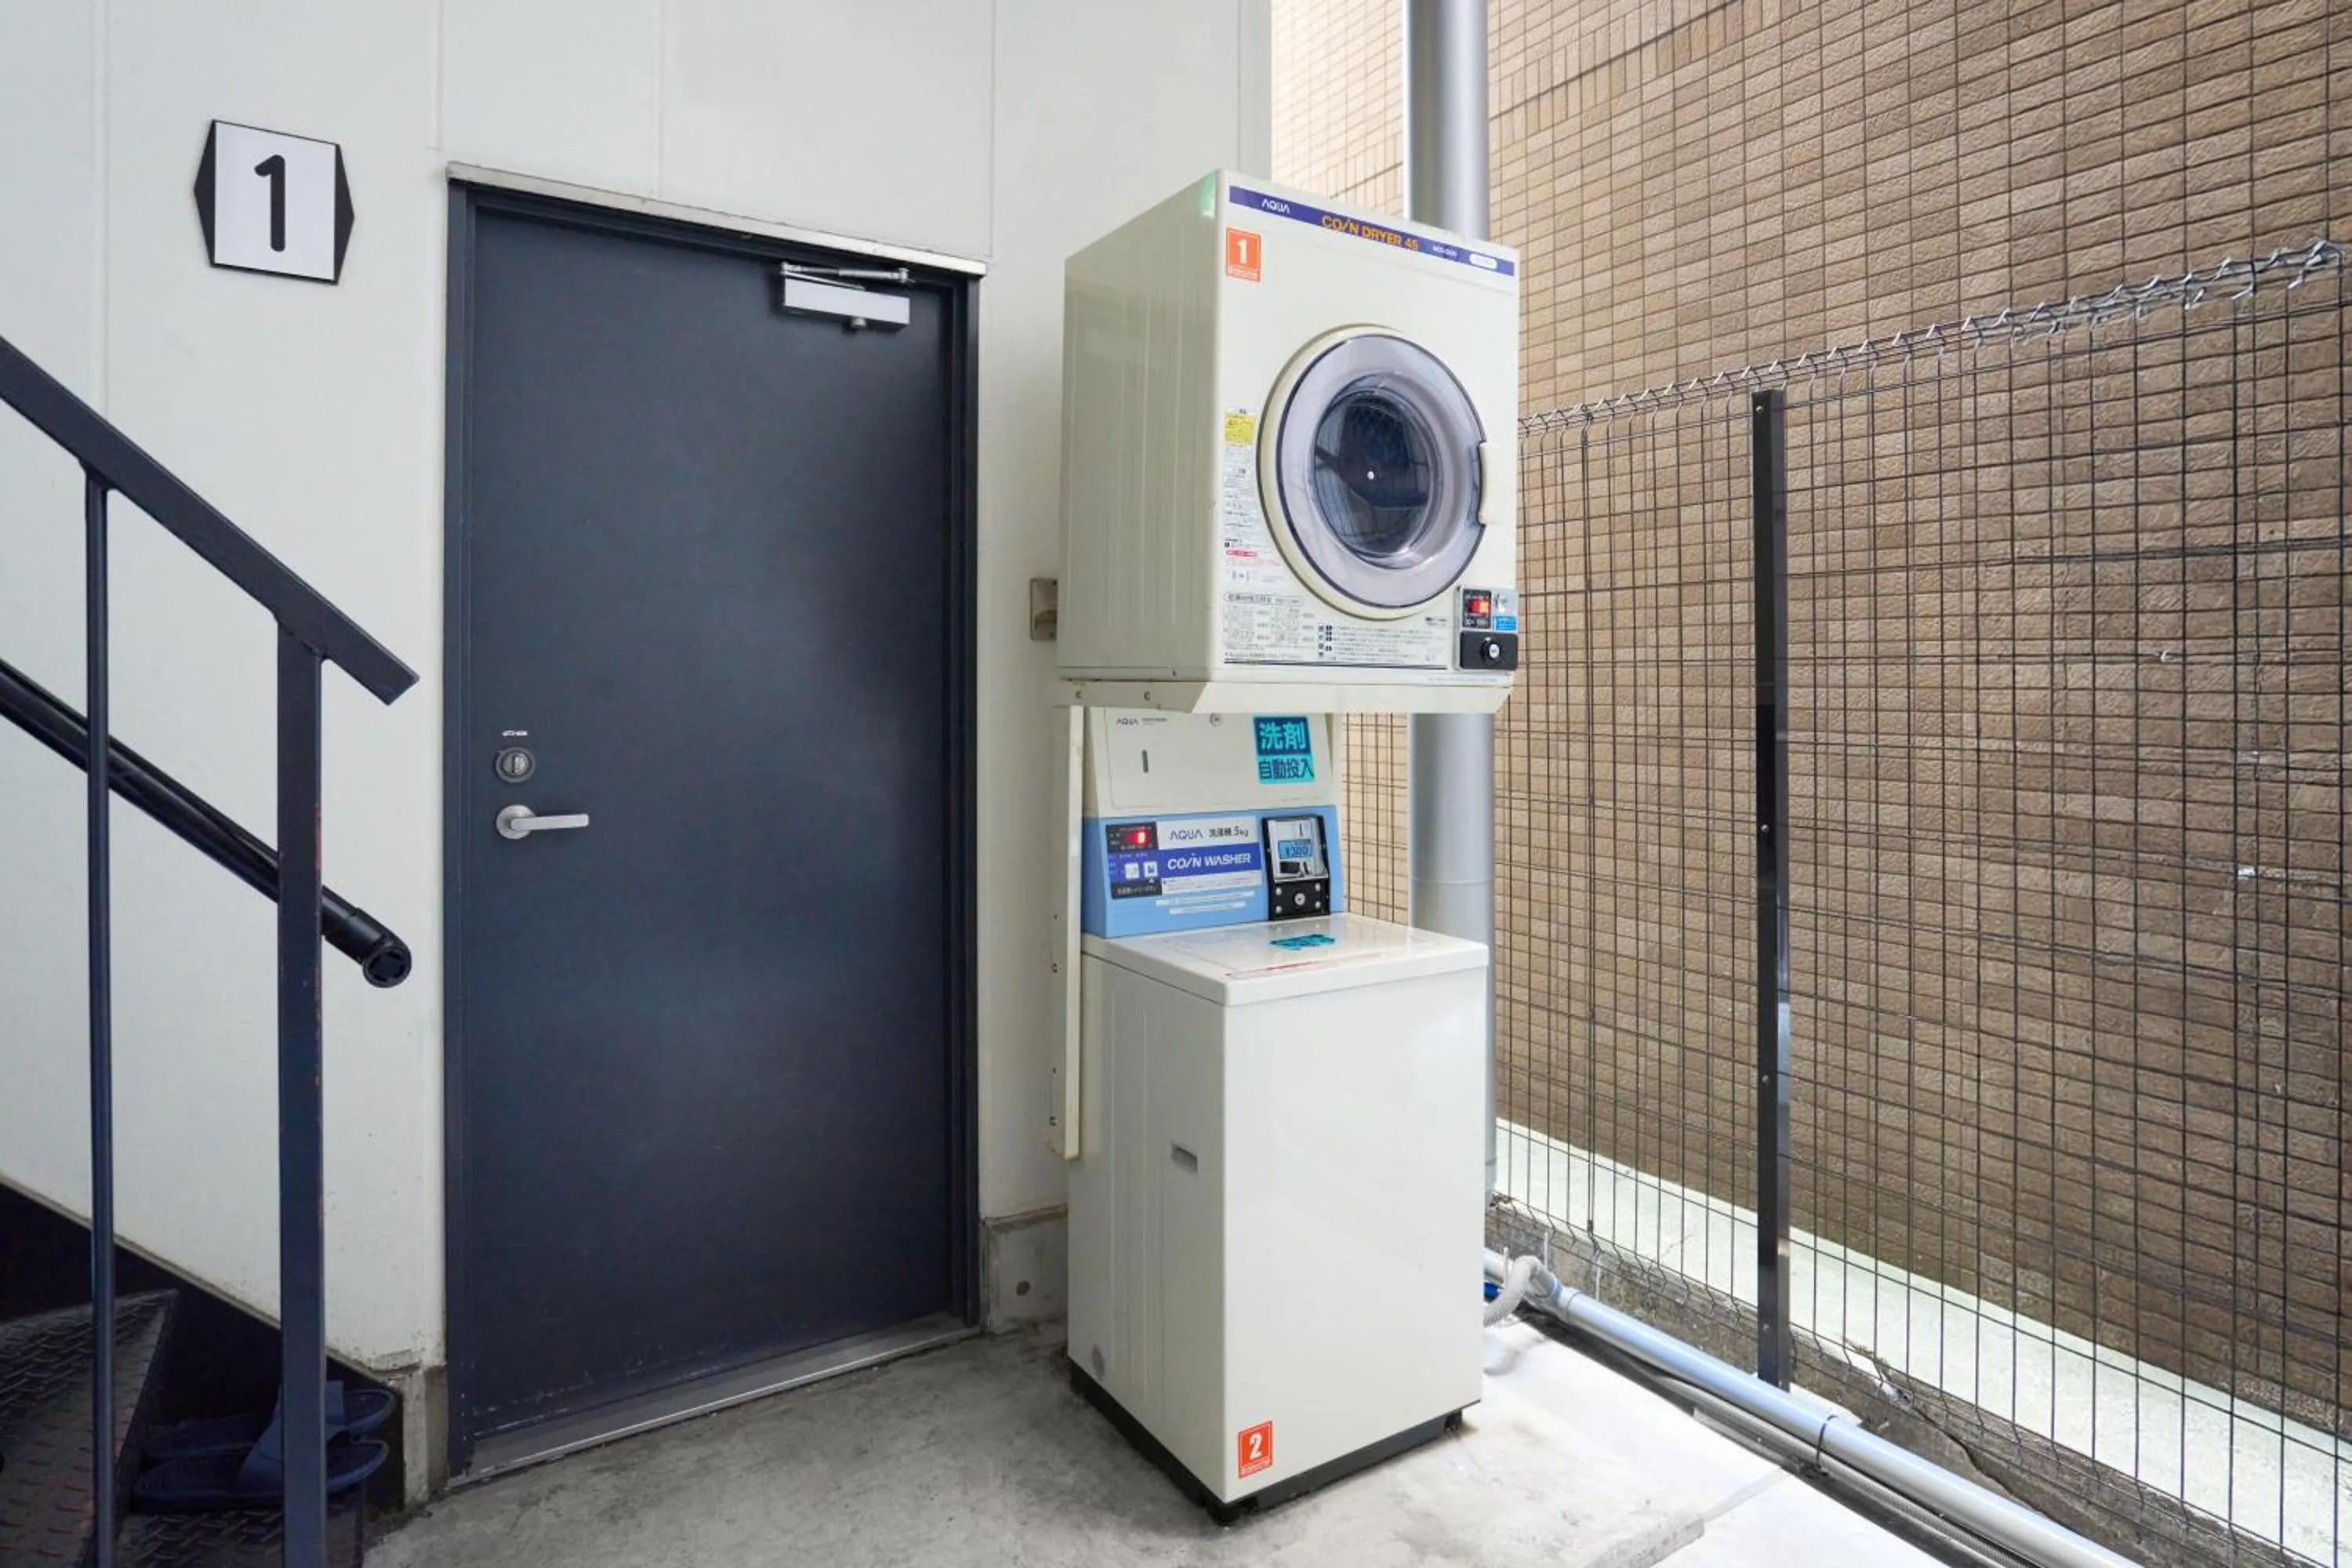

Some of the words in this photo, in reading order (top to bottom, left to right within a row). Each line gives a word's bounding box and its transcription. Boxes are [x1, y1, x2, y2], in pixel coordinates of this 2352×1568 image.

[254, 154, 286, 253] 1
[1261, 198, 1291, 214] AQUA
[1236, 238, 1248, 265] 1
[1362, 225, 1402, 245] DRYER
[1404, 238, 1418, 252] 45
[1258, 720, 1307, 750] 洗剤
[1258, 757, 1315, 780] 自動投入
[1169, 829, 1203, 841] AQUA
[1204, 852, 1252, 866] WASHER
[1249, 1432, 1263, 1460] 2
